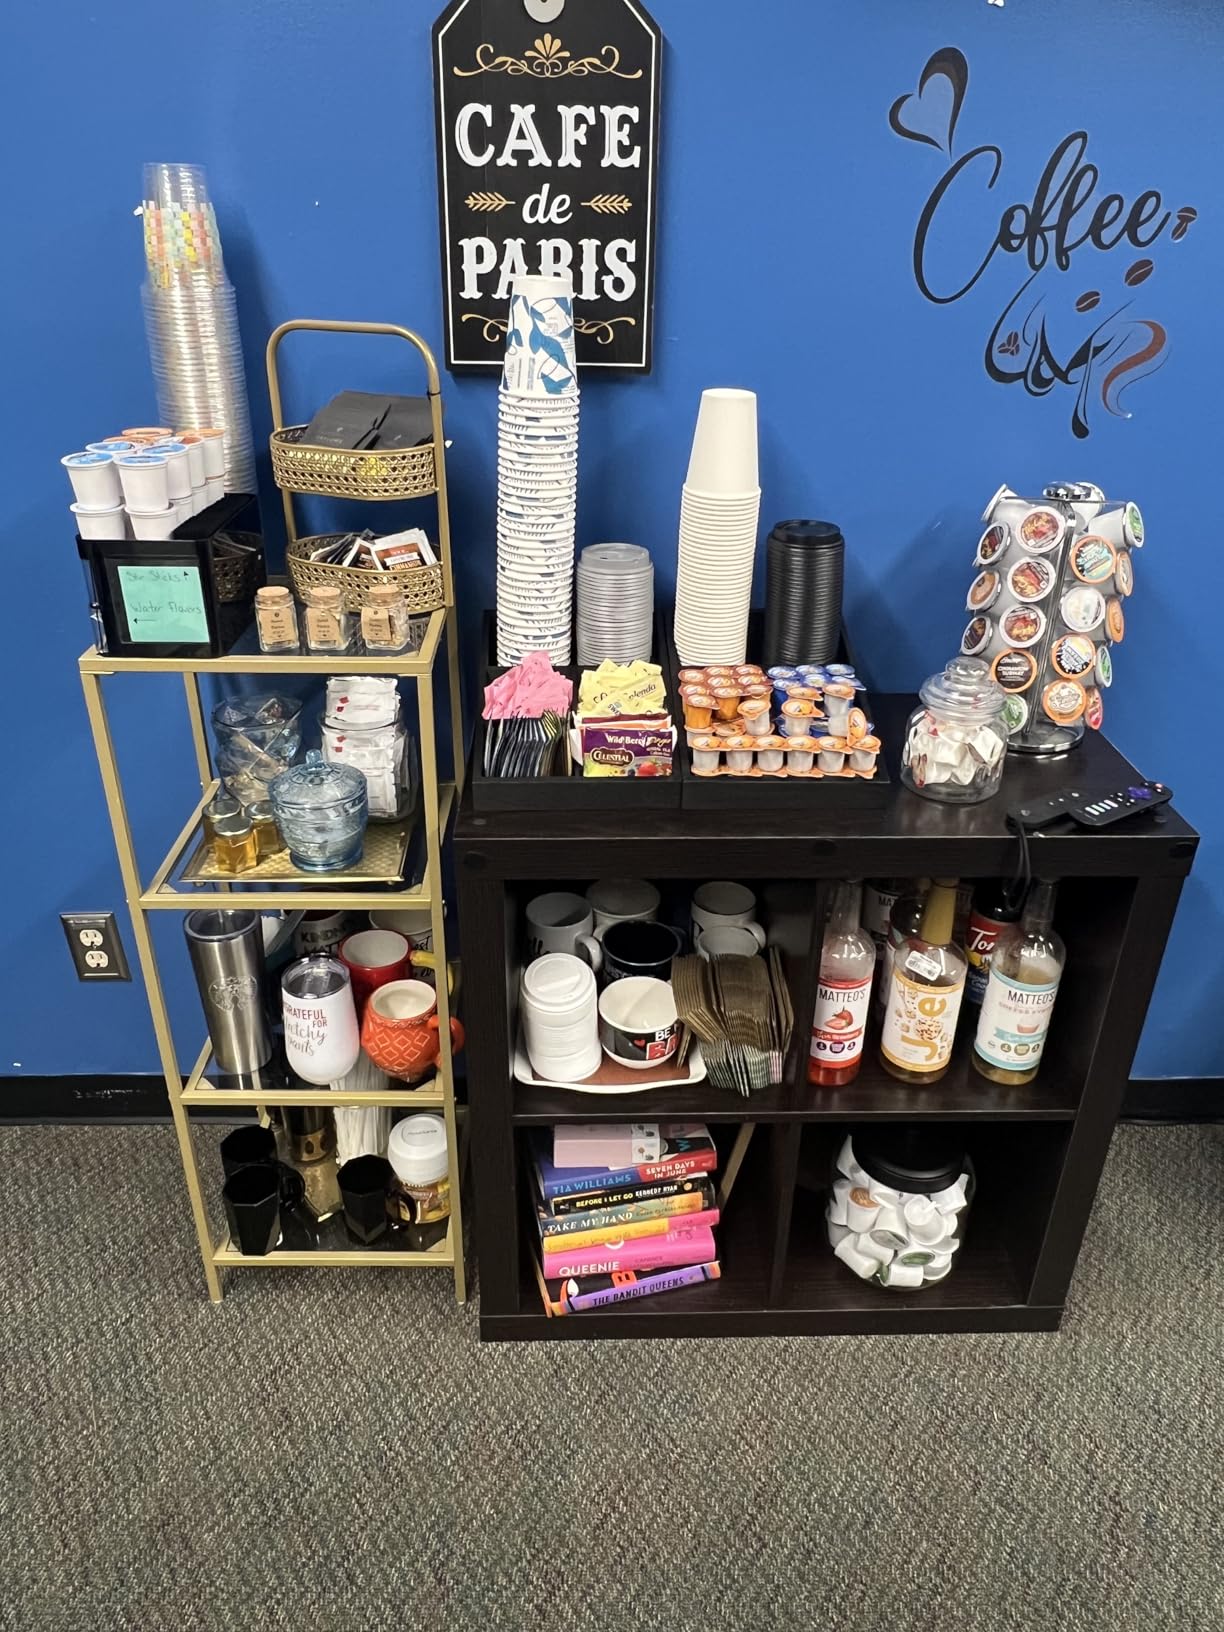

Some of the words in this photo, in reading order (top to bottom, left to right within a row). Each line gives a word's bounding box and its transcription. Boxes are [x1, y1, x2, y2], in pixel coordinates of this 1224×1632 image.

[454, 103, 641, 168] CAFE
[522, 183, 573, 224] de
[914, 130, 1171, 304] Coffee
[458, 237, 636, 301] PARIS
[130, 601, 162, 614] Water
[168, 601, 202, 614] Flavors
[605, 733, 624, 743] Wild
[593, 750, 630, 763] CELESTIAL
[819, 988, 866, 1003] MATTEO'S
[1007, 990, 1055, 1005] MATTEO'S
[312, 1019, 328, 1028] FOR
[655, 1027, 672, 1041] BE
[646, 1163, 673, 1175] SEVEN
[674, 1160, 695, 1170] DAYS
[666, 1168, 687, 1178] JUNE
[552, 1184, 572, 1195] TIA
[574, 1174, 632, 1190] WILLIAMS
[576, 1197, 603, 1208] BEFORE
[609, 1194, 622, 1203] LET
[623, 1192, 634, 1200] GO
[635, 1187, 661, 1198] KENNEDY
[546, 1221, 577, 1235] TAKE
[580, 1217, 599, 1228] MY
[601, 1211, 633, 1225] HAND
[558, 1261, 620, 1277] QUEENIE
[592, 1296, 609, 1306] THE
[613, 1285, 648, 1302] BANDIT
[649, 1276, 685, 1292] QUEENS
